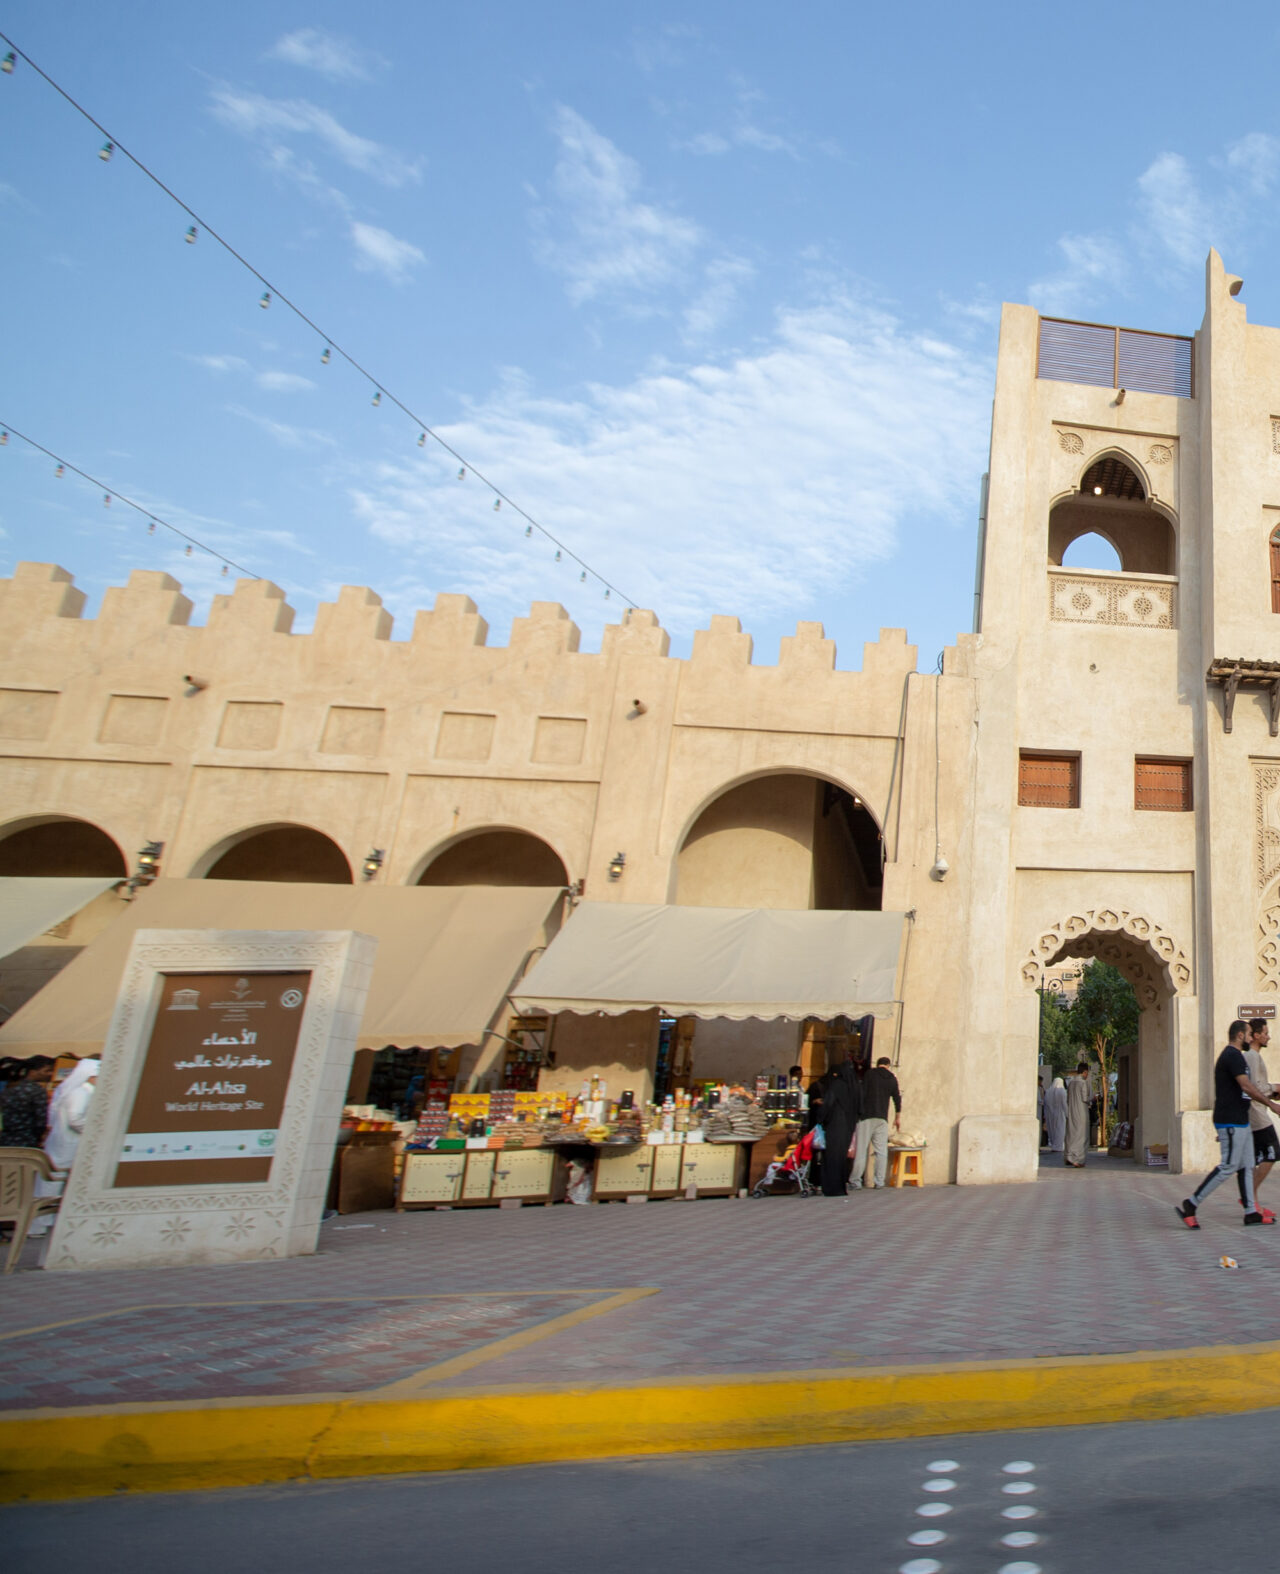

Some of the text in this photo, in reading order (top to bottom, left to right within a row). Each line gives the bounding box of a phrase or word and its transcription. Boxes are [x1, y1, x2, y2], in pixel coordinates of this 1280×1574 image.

[202, 1028, 257, 1045] الأحساء
[174, 1054, 272, 1070] موقع تراث عالمي
[185, 1081, 247, 1096] Al-Ahsa
[165, 1099, 265, 1112] World Heritage Site
